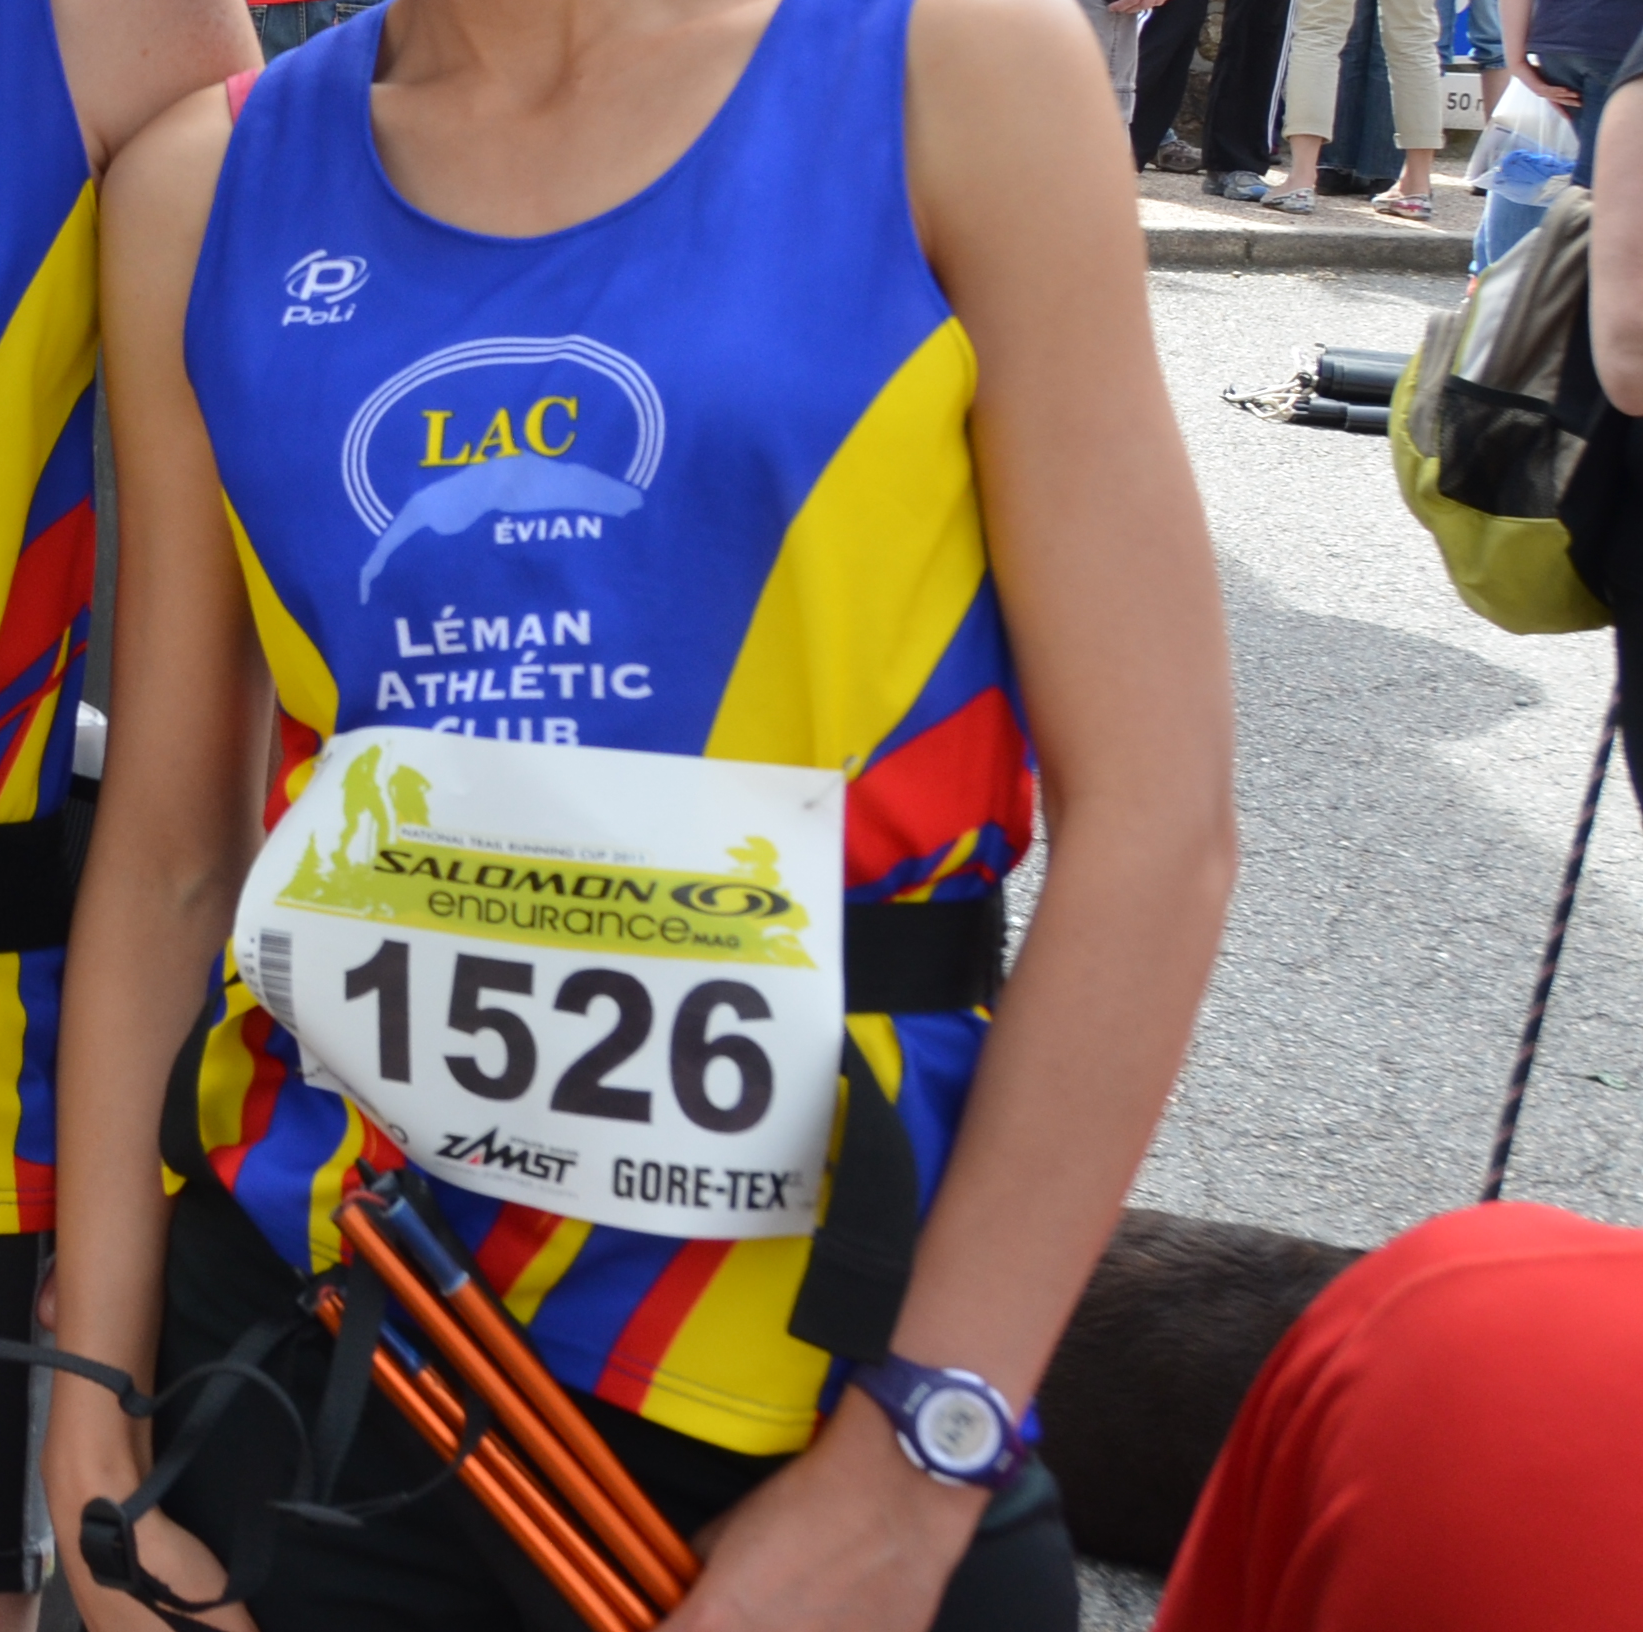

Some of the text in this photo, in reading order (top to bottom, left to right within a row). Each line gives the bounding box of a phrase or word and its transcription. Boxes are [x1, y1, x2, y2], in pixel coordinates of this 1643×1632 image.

[1447, 92, 1470, 110] 50
[419, 395, 579, 468] LAC
[494, 516, 602, 545] ÉVIAN
[394, 606, 591, 658] LÉMAN
[376, 653, 653, 711] ATHLÉTIC
[373, 849, 656, 904] SALOMON
[344, 938, 775, 1135] 1526
[613, 1157, 789, 1210] GORE-TEX
